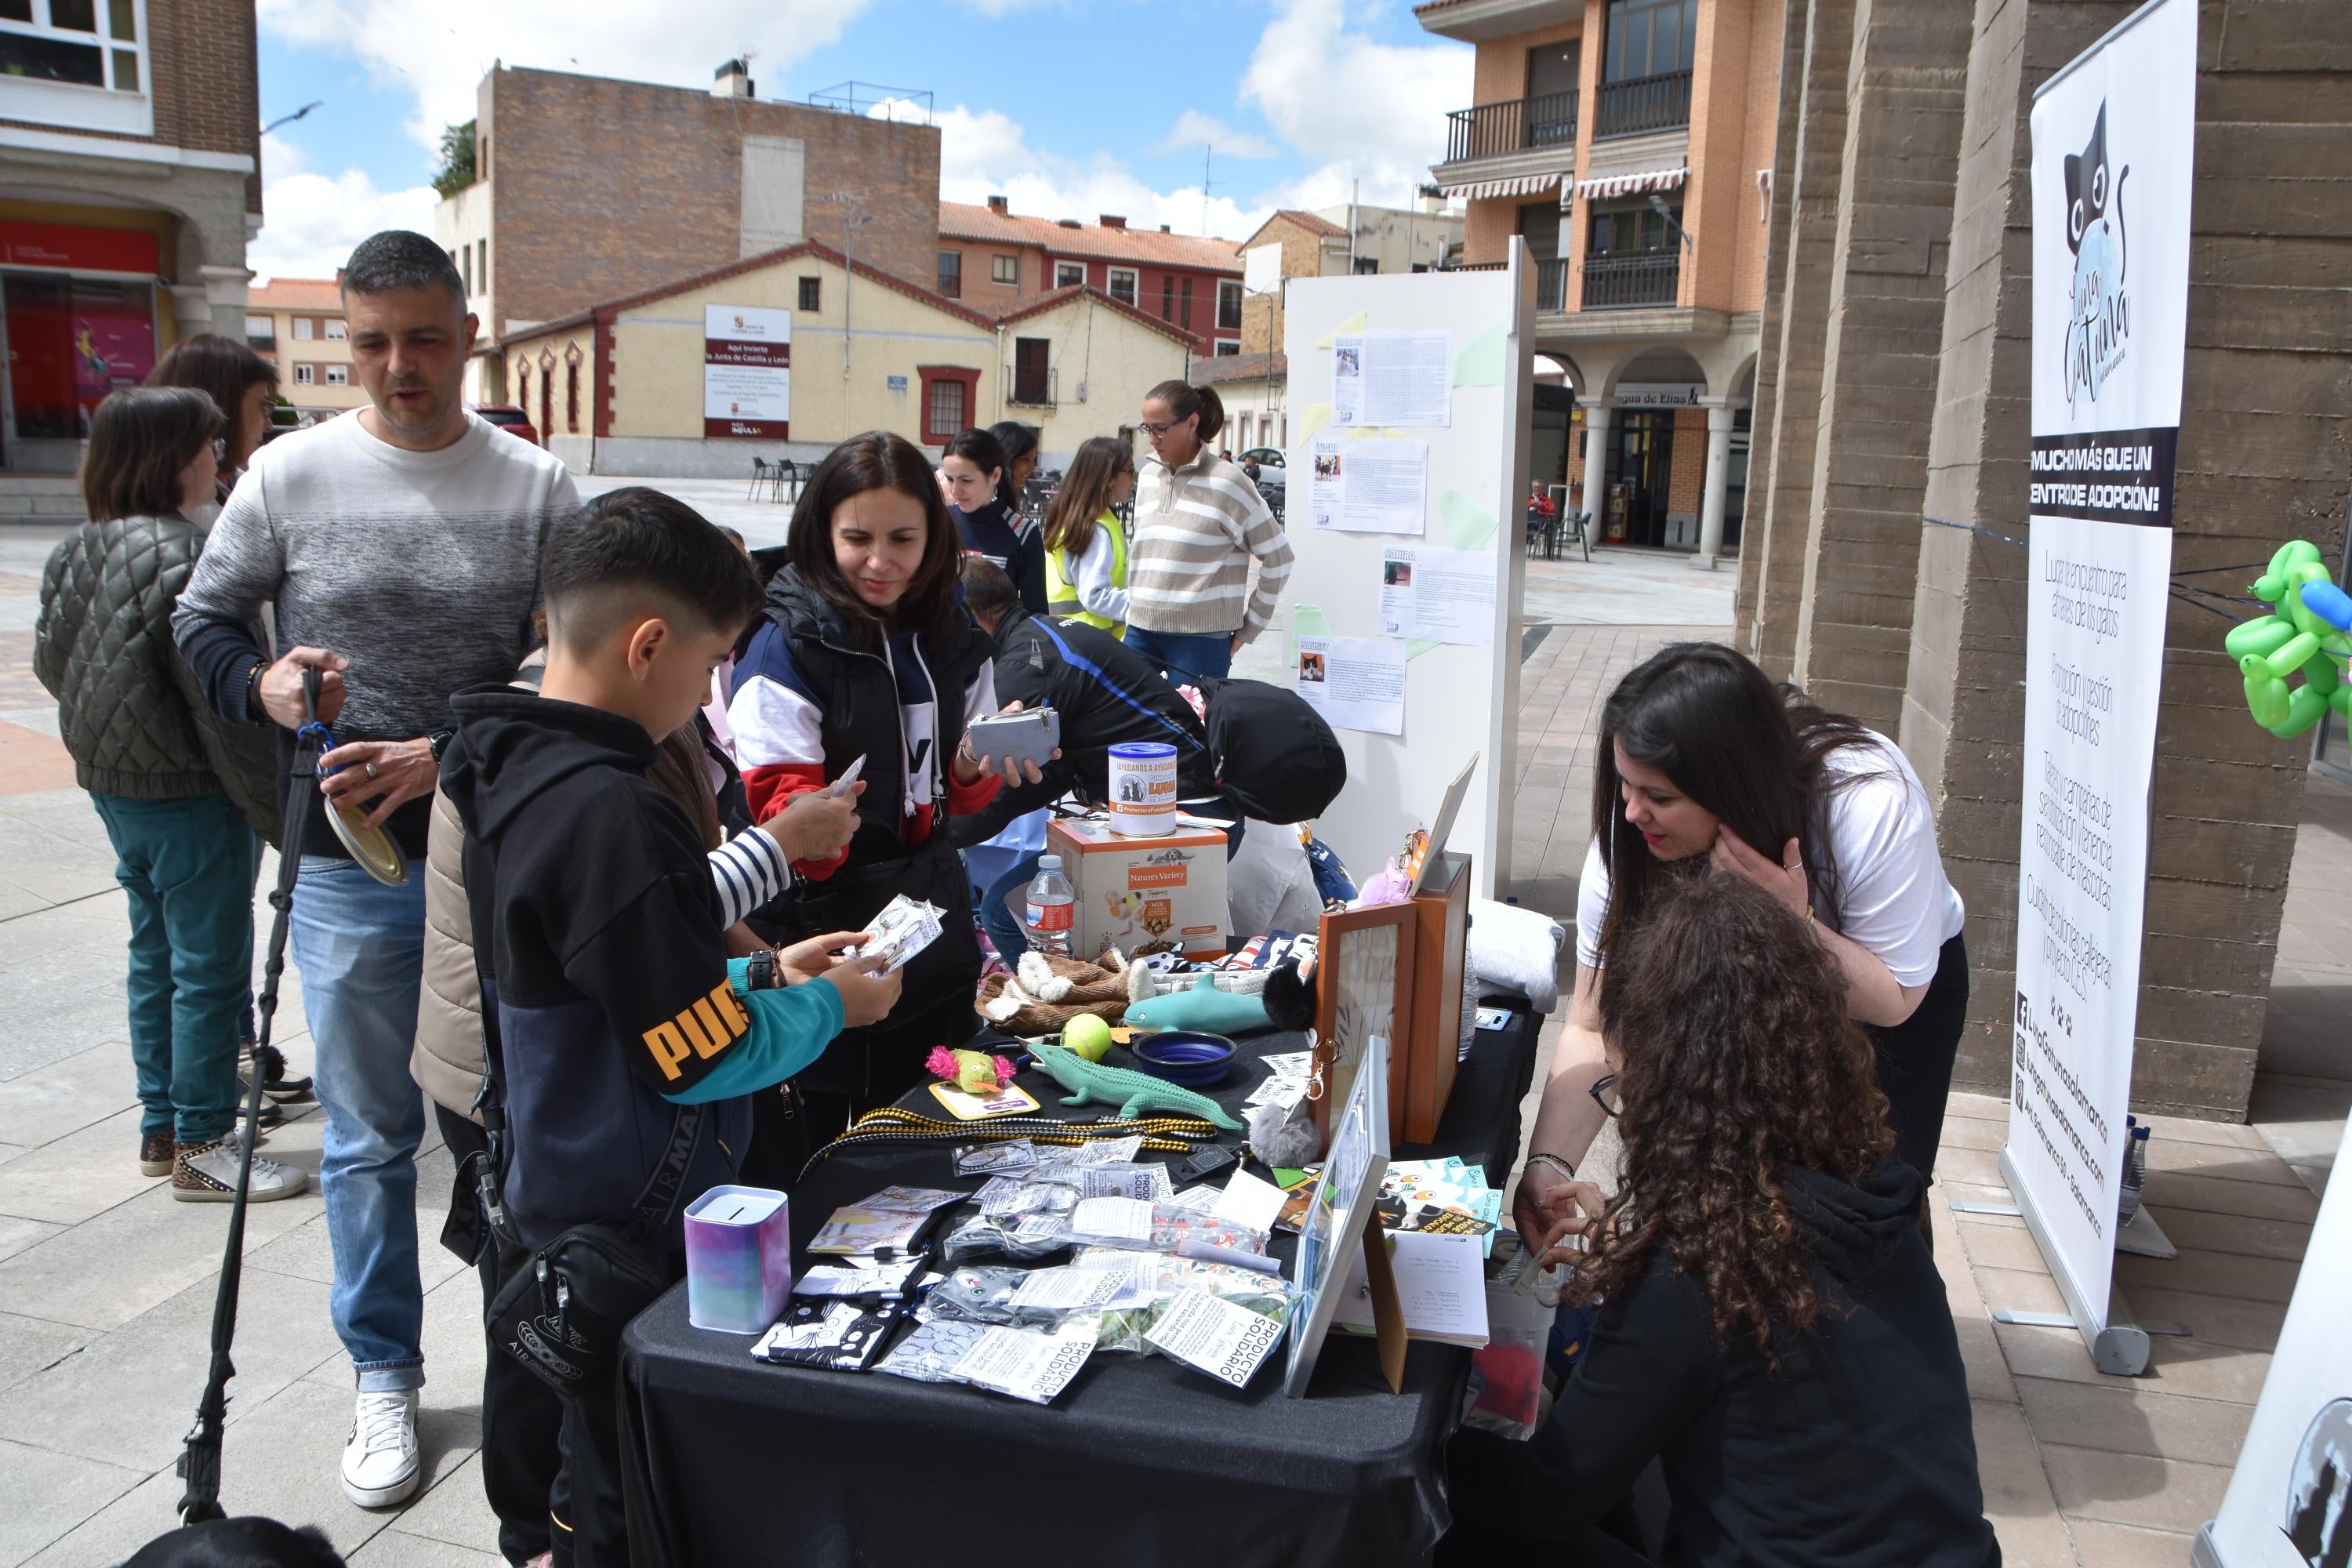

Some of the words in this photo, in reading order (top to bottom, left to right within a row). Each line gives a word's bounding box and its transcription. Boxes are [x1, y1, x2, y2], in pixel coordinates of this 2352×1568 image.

[2069, 270, 2101, 327] Luna
[1644, 394, 1657, 403] de
[1316, 443, 1338, 452] TIGRI
[2075, 439, 2102, 471] MÁS
[2103, 446, 2132, 471] QUE
[2134, 445, 2153, 470] UN
[2030, 483, 2071, 506] ENTRO
[2071, 484, 2087, 506] DE
[2088, 477, 2160, 512] ADOPCIÓN!
[1385, 549, 1416, 561] SAHIRA
[2108, 570, 2126, 604] para
[2074, 590, 2086, 627] de
[2096, 599, 2118, 644] gatos
[2101, 790, 2111, 830] de
[2082, 818, 2112, 871] tenencia
[1131, 873, 1158, 882] Nature's
[1160, 872, 1184, 880] Variety
[2066, 842, 2076, 880] de
[2077, 860, 2111, 911] mascotas
[1147, 889, 1168, 898] Toppers
[668, 1105, 701, 1172] MA
[2033, 1114, 2060, 1167] Salamanca
[2070, 1174, 2101, 1240] Salamanca
[1452, 1218, 1475, 1233] PUEDE
[1184, 1291, 1202, 1308] seguir
[1185, 1301, 1204, 1318] ayuda
[1165, 1308, 1191, 1332] salvando
[1178, 1318, 1191, 1328] nos
[508, 1341, 529, 1362] AIR
[1156, 1331, 1171, 1345] vidas
[1161, 1327, 1182, 1348] permite
[1220, 1316, 1266, 1376] SOLIDARIO
[1232, 1321, 1279, 1383] PRODUCTO
[1031, 1341, 1077, 1392] SOLIDARIO
[1044, 1341, 1091, 1394] PRODUCTO
